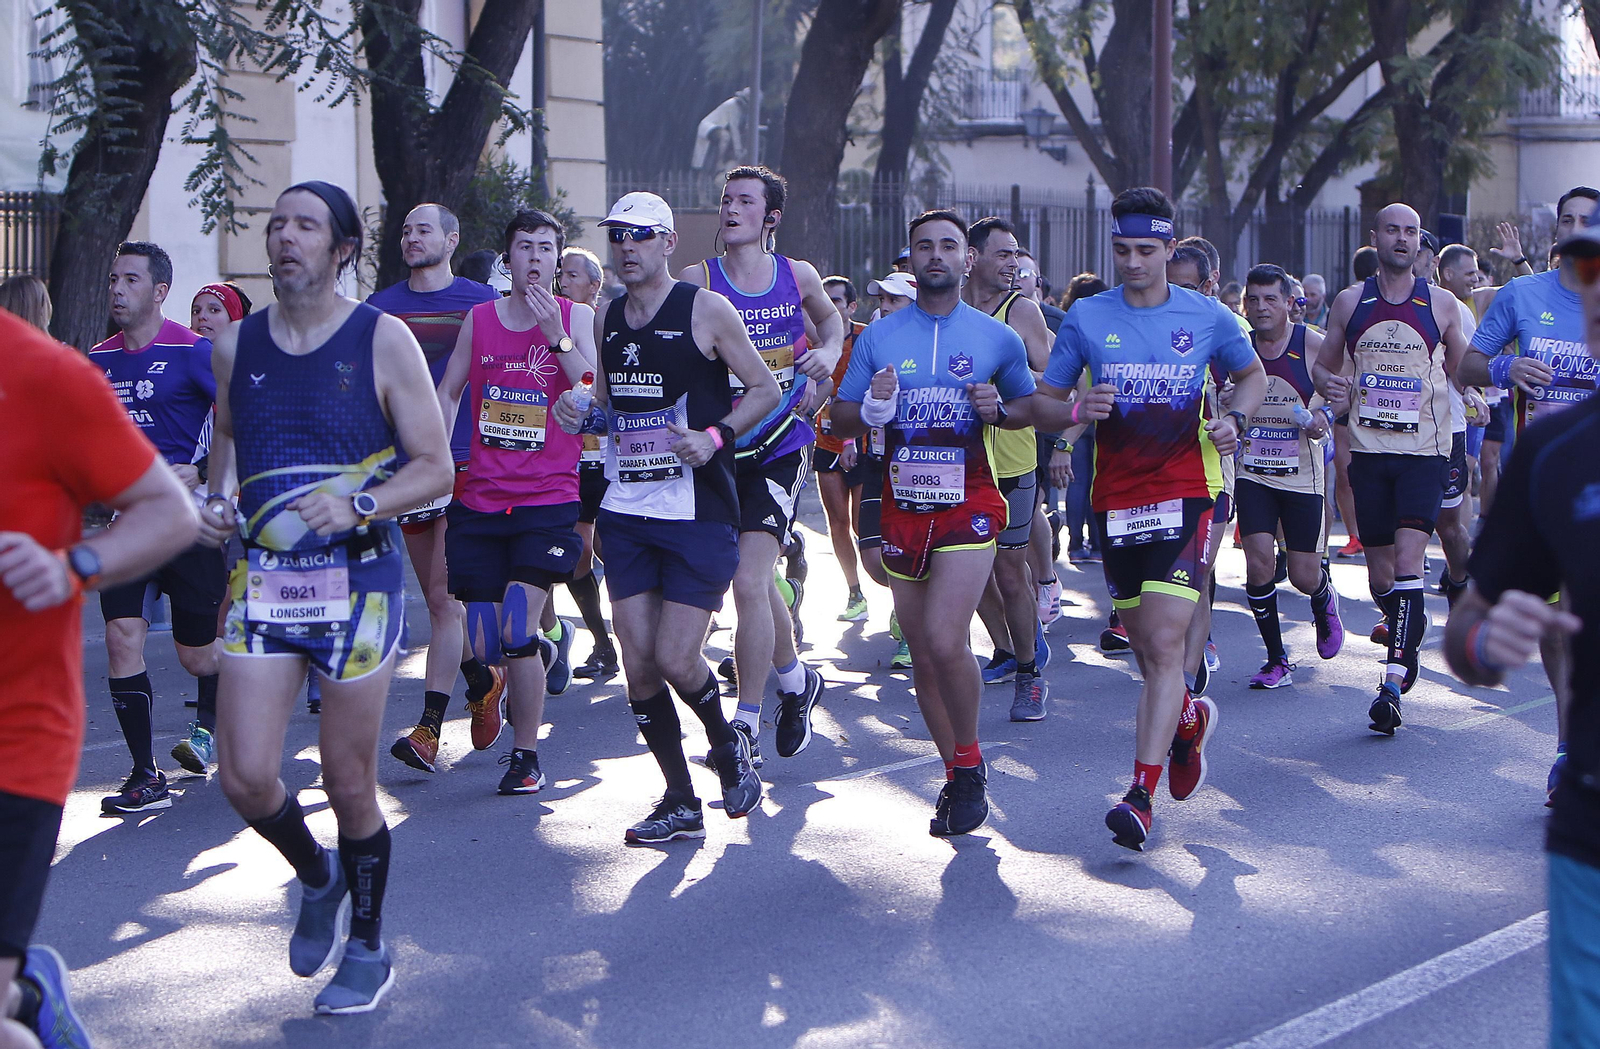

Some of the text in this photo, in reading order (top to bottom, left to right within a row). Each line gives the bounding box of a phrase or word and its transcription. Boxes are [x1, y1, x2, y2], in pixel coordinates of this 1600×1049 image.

[738, 302, 796, 321] ncreatic
[746, 323, 772, 335] cer
[1360, 340, 1400, 350] PÉGATE
[1529, 336, 1591, 357] INFORM
[481, 354, 494, 365] Jo's
[505, 361, 526, 369] trust
[1101, 363, 1197, 380] INFORMALES
[1375, 363, 1405, 373] JORGE
[629, 372, 663, 385] AUTO
[1574, 373, 1597, 381] ALCOR
[1378, 381, 1414, 389] ZURICH
[502, 391, 540, 403] ZURICH
[898, 386, 969, 404] FORMAL
[1377, 397, 1401, 409] 8010
[499, 412, 525, 425] 5575
[1251, 416, 1292, 425] CRISTOBAL
[1376, 411, 1399, 420] JORGE
[626, 416, 666, 429] ZURICH
[932, 421, 956, 429] ALCOR
[483, 424, 539, 440] GEORGE SMYLY
[1261, 430, 1293, 438] ZURICH
[630, 441, 656, 454] 6817
[1260, 447, 1283, 456] 8157
[619, 455, 678, 468] CHARAFA KAMEL
[912, 450, 956, 461] ZURICH
[1253, 458, 1288, 466] CRISTOBAL
[911, 474, 941, 486] 8083
[895, 488, 961, 501] SEBASTIÁN POZO
[1126, 517, 1162, 531] PATARRA
[280, 552, 335, 569] ZURICH
[280, 585, 316, 600] 6921
[270, 605, 327, 619] LONGSHOT
